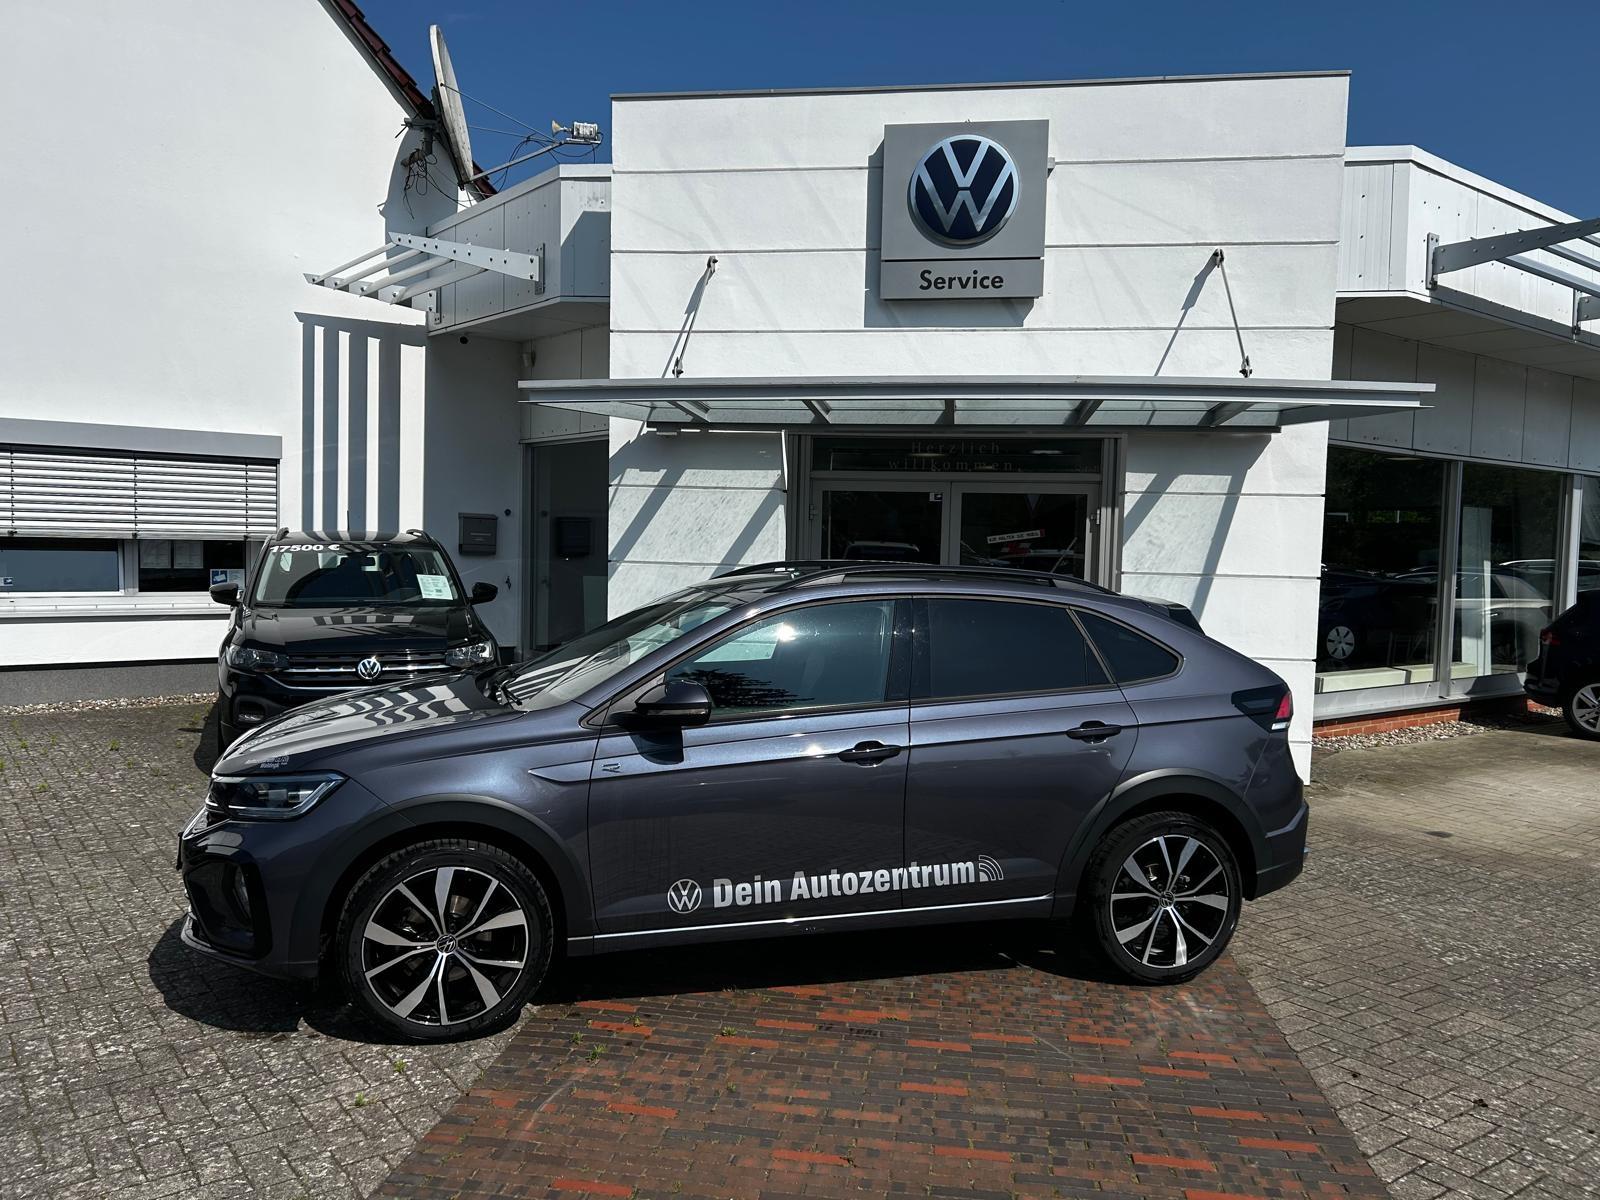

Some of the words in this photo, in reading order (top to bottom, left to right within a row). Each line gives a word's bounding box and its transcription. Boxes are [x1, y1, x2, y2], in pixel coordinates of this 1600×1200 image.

[919, 268, 1004, 291] Service
[911, 440, 1000, 455] Herzlich
[270, 544, 324, 553] 17500
[713, 874, 783, 909] Dein
[790, 860, 976, 901] Autozentrum
